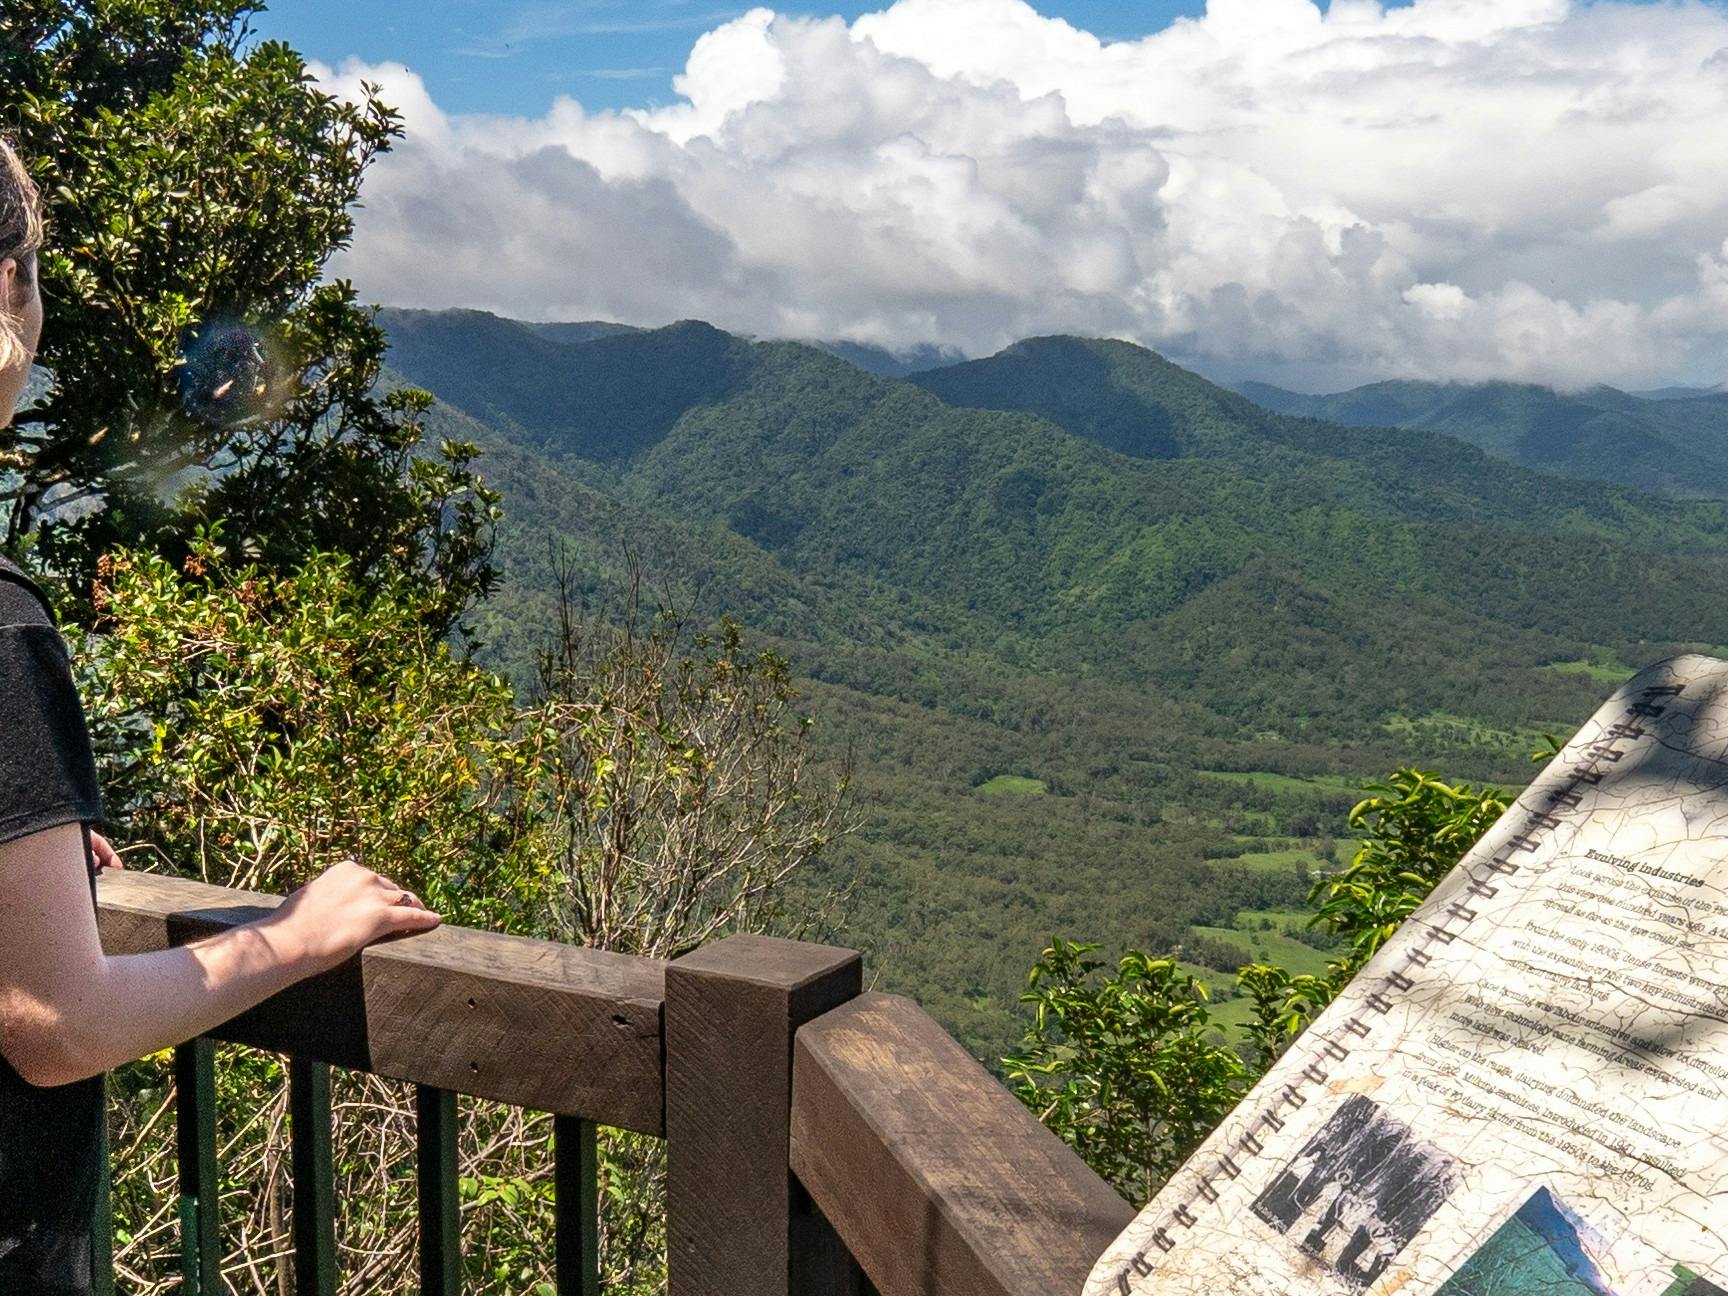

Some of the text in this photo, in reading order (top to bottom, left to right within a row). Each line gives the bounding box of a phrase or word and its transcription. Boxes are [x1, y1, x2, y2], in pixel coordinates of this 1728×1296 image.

[1583, 848, 1703, 887] Evolving industries
[1623, 881, 1640, 891] the
[1691, 900, 1710, 911] the
[1612, 919, 1629, 930] the
[1655, 913, 1685, 925] years
[1622, 954, 1651, 969] dense
[1651, 963, 1687, 980] forests
[1621, 976, 1642, 988] two
[1641, 982, 1662, 996] key
[1661, 989, 1715, 1013] industries
[1448, 1014, 1546, 1056] more land was cleared.
[1478, 978, 1498, 990] Cane
[1499, 986, 1535, 1006] farming
[1552, 1006, 1584, 1023] labour
[1583, 1018, 1629, 1040] intensive
[1630, 1037, 1654, 1048] and
[1652, 1044, 1676, 1058] slow
[1503, 1010, 1722, 1100] technology cane farming areas expanded and
[1515, 1072, 1626, 1125] dairying dominated the
[1513, 1120, 1539, 1137] from
[1541, 1108, 1688, 1178] introduced resulted
